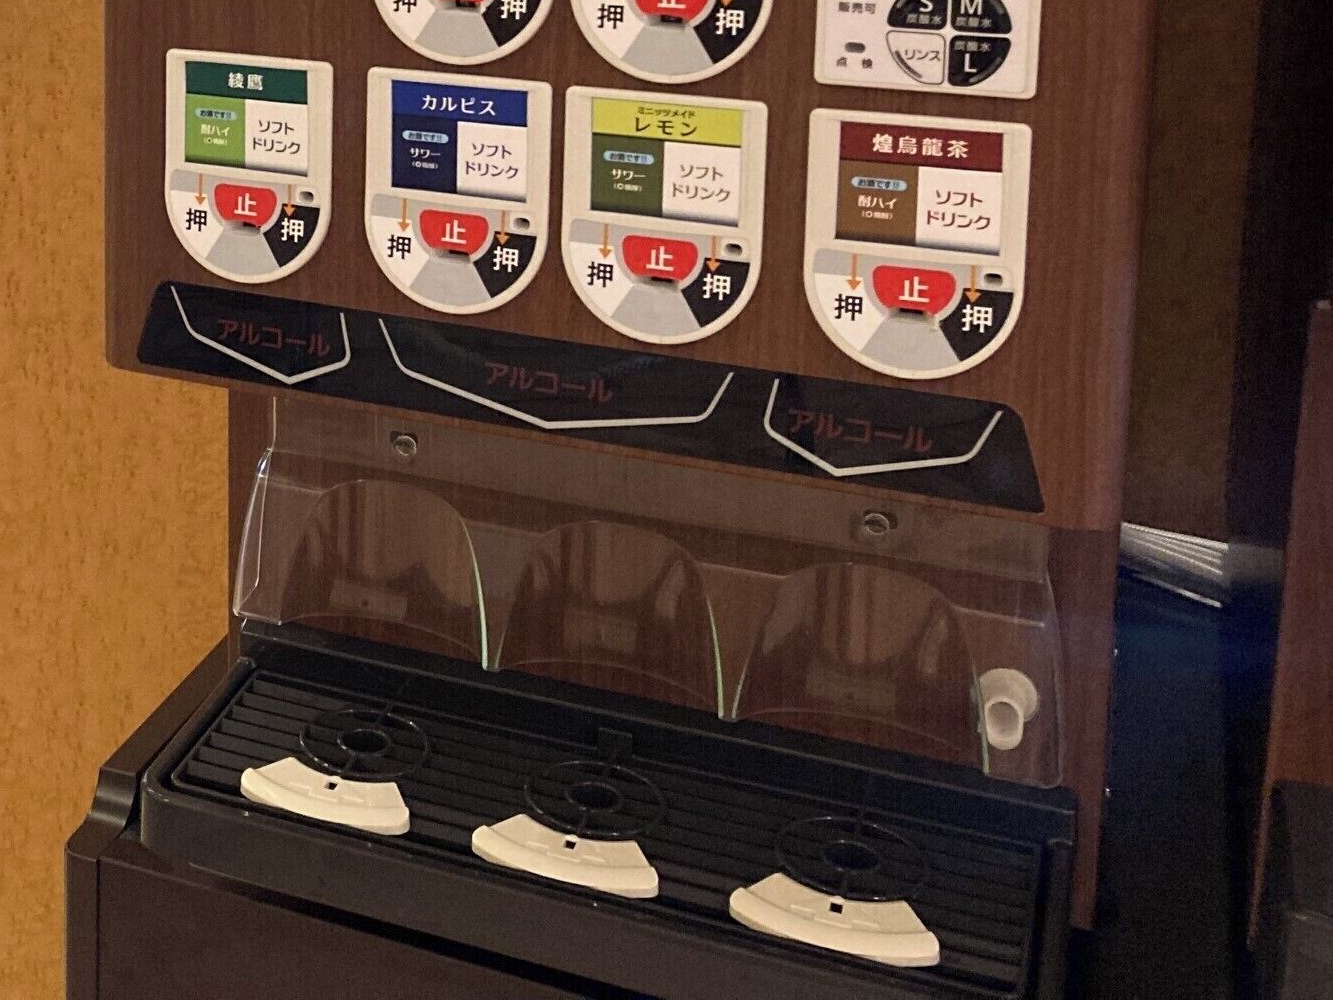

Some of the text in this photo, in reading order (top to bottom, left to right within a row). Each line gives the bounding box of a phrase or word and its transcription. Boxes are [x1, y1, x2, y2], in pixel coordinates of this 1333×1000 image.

[597, 2, 624, 30] 押
[715, 8, 744, 36] 押
[903, 49, 941, 62] リンス
[964, 53, 978, 73] L
[421, 94, 496, 116] カルピス
[637, 106, 696, 119] ミニッツメイド
[258, 120, 295, 135] ソフト
[635, 116, 698, 137] レモン
[252, 137, 301, 155] ドリンク
[410, 147, 441, 158] サワー
[472, 143, 512, 159] ソフト
[465, 161, 519, 179] ドリンク
[611, 168, 646, 180] サワー
[680, 164, 724, 181] ソフト
[672, 183, 730, 202] ドリンク
[857, 195, 897, 209] 酎ハイ
[935, 189, 983, 208] ソフト
[233, 193, 257, 216] 止
[185, 207, 208, 232] 押
[281, 218, 305, 242] 押
[926, 210, 991, 230] ドリンク
[441, 219, 466, 244] 止
[387, 234, 411, 259] 押
[646, 245, 674, 271] 止
[492, 245, 519, 273] 押
[587, 261, 614, 288] 押
[703, 273, 731, 301] 押
[898, 276, 930, 305] 止
[833, 292, 863, 322] 押
[962, 304, 993, 335] 押
[217, 318, 331, 357] アルコール
[484, 360, 613, 403] アルコール
[788, 408, 934, 451] アルコール
